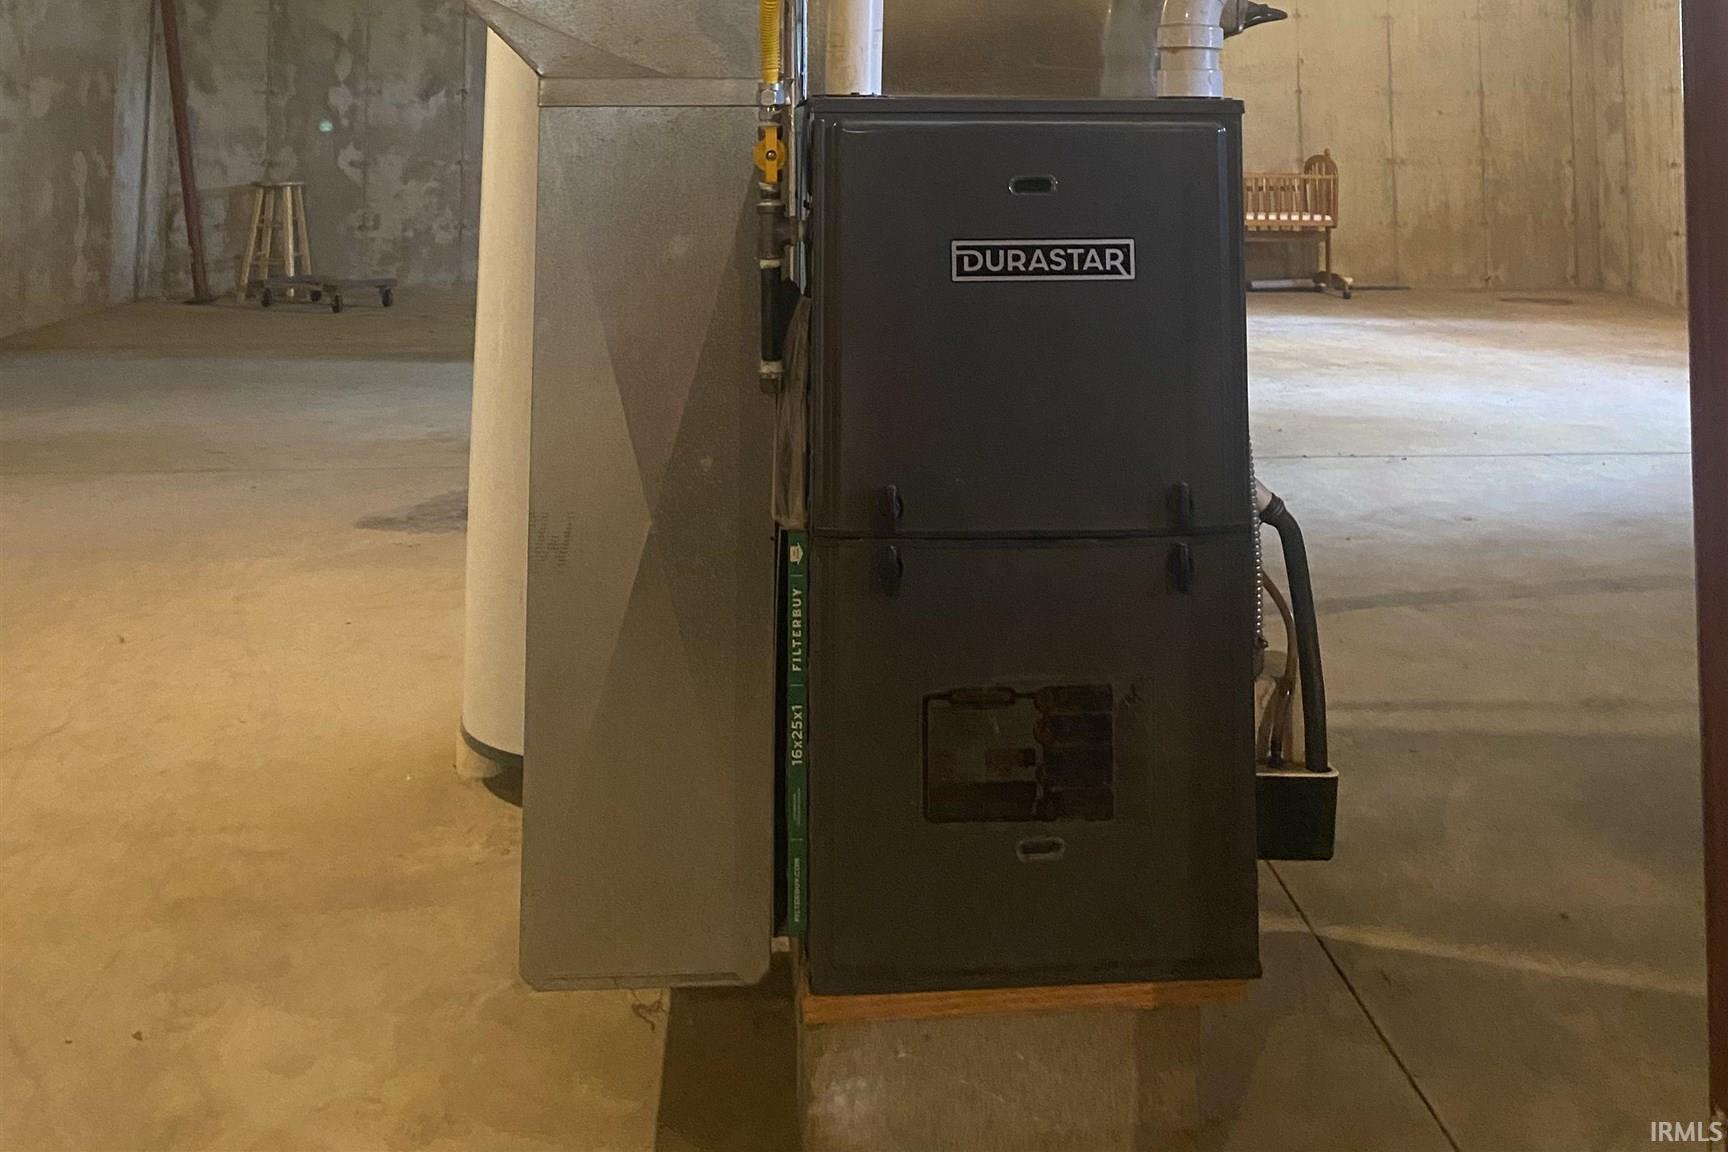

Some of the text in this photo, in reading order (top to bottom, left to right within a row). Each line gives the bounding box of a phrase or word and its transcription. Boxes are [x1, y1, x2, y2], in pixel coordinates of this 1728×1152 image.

[956, 247, 1130, 276] DURASTAR
[792, 588, 802, 672] FILTERBUY
[791, 704, 803, 766] 16x25x1
